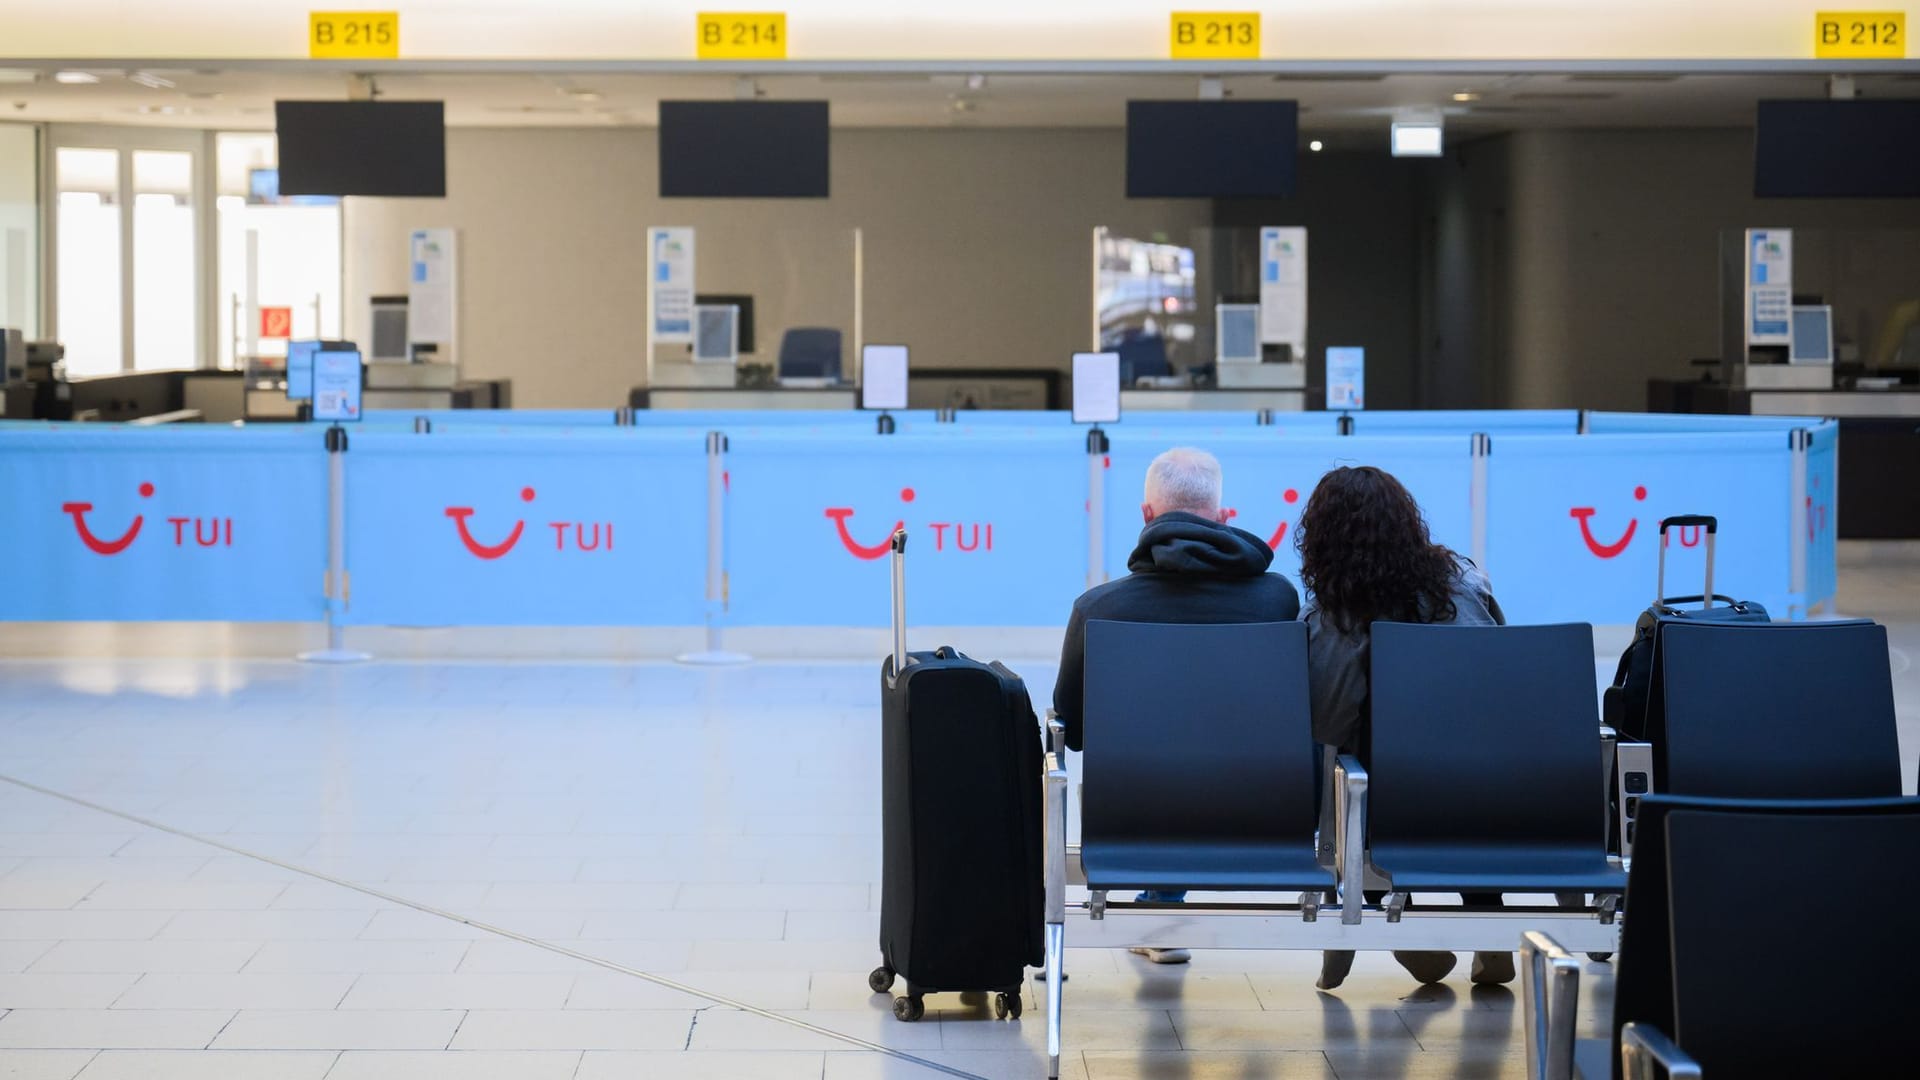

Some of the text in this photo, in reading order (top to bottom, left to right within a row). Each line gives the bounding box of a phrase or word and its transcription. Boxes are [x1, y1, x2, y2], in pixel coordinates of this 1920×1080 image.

[316, 22, 391, 45] B 215
[704, 22, 778, 45] B 214
[1178, 22, 1252, 44] B 213
[1822, 22, 1898, 44] B 212
[167, 517, 233, 547] TUI
[549, 522, 613, 551] TUI
[929, 522, 992, 551] TUI
